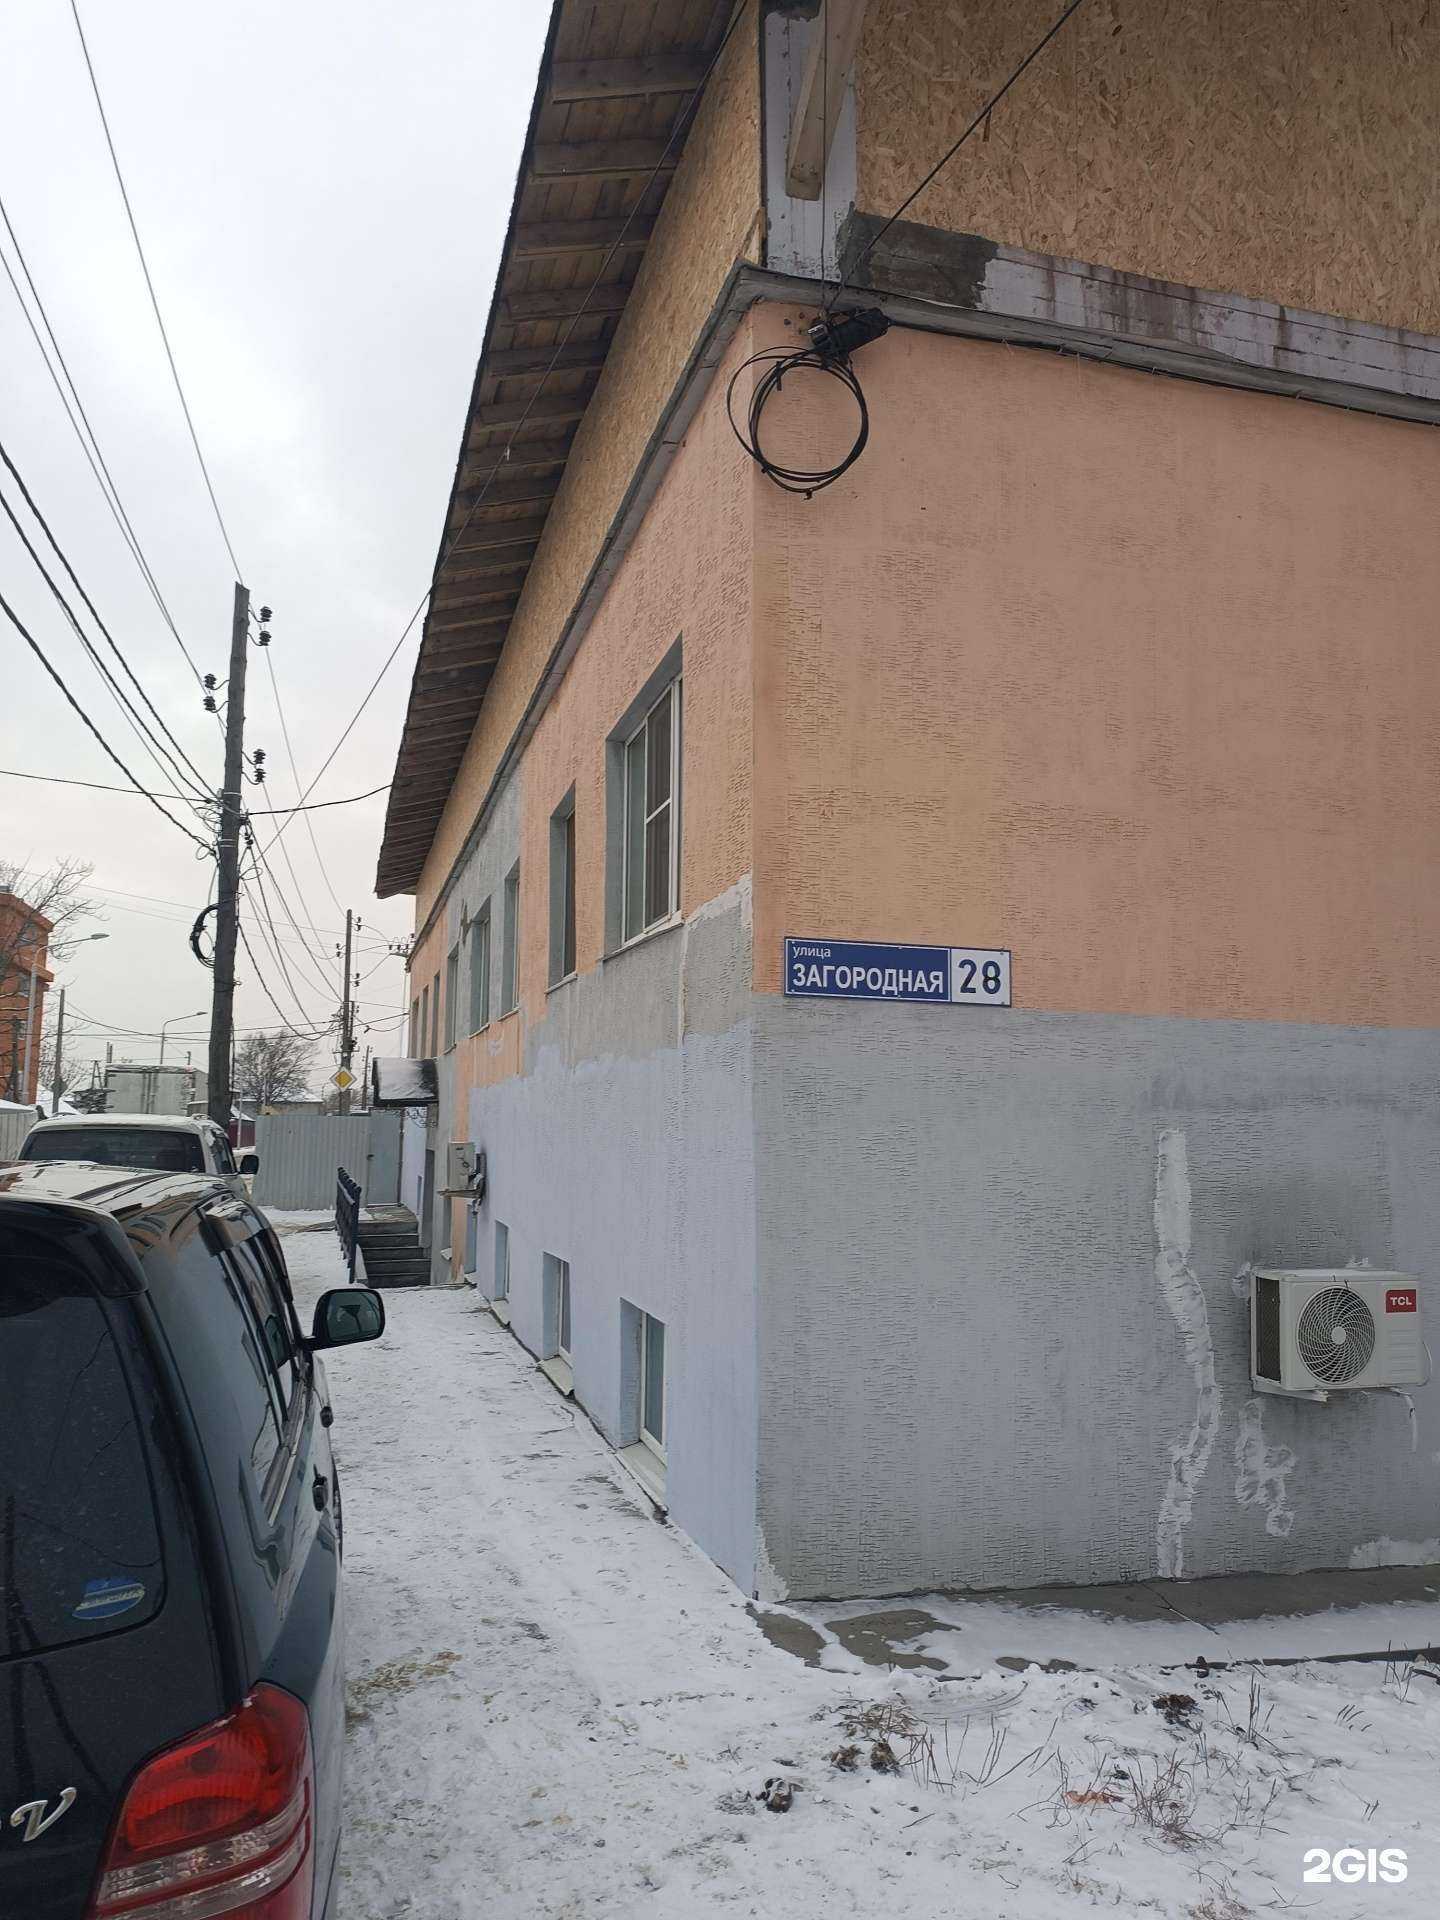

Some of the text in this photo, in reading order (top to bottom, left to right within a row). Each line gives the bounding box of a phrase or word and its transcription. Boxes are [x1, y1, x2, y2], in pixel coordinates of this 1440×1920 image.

[792, 946, 831, 959] улица
[792, 963, 944, 996] ЗАГОРОДНАЯ
[957, 958, 1001, 995] 28
[1390, 1296, 1413, 1306] TCL
